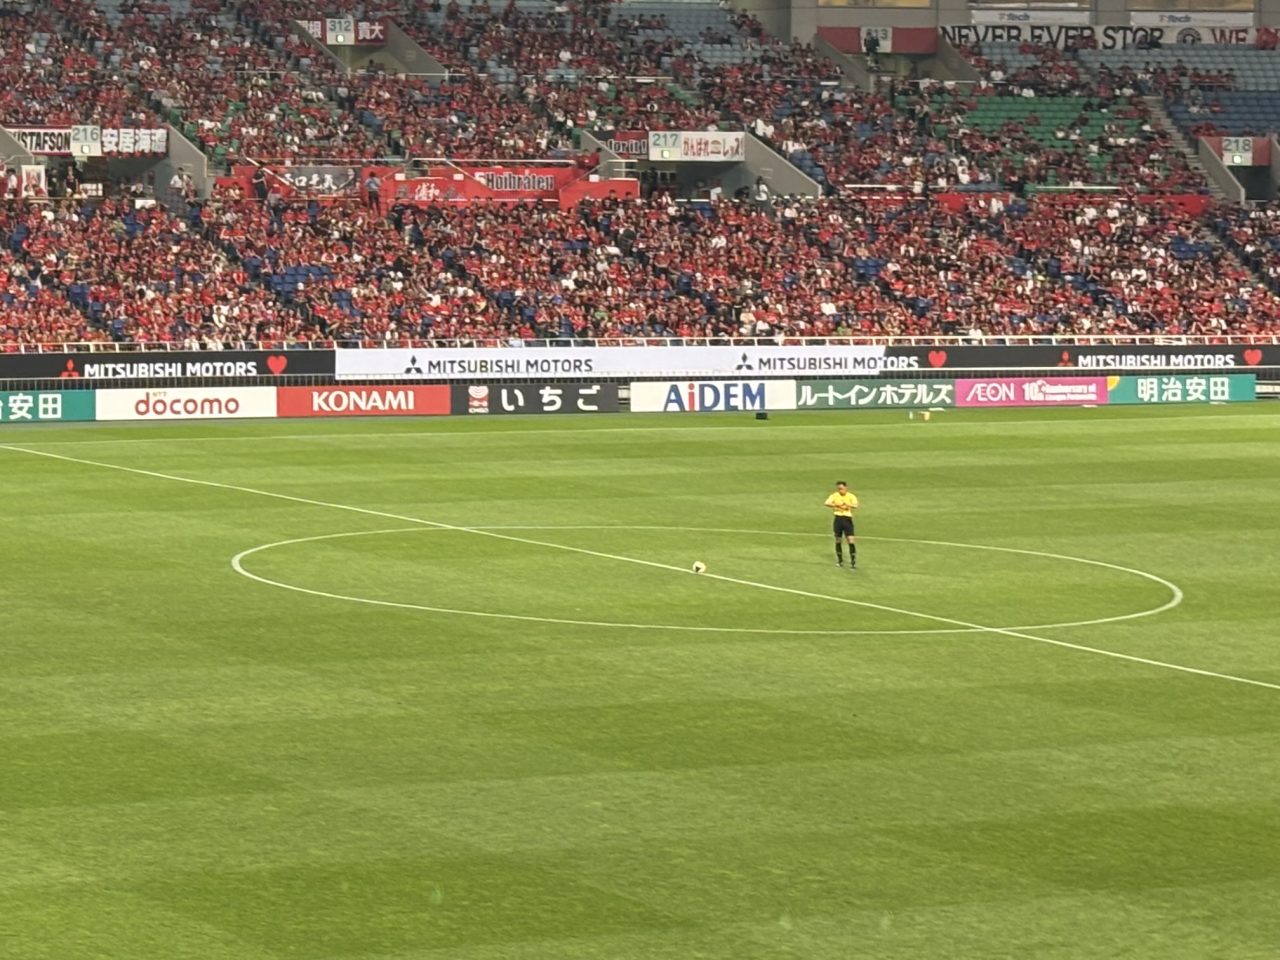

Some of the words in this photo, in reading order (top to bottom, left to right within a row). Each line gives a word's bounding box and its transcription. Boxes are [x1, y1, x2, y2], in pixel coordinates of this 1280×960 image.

[329, 20, 352, 33] 312
[940, 25, 1022, 48] NEVER
[1031, 25, 1096, 52] EVER
[72, 127, 99, 142] 216
[652, 132, 679, 146] 217
[1223, 138, 1252, 152] 218
[84, 361, 182, 378] MITSUBISHI
[185, 360, 257, 376] MOTORS
[427, 359, 521, 374] MITSUBISHI
[526, 358, 593, 373] MOTORS
[758, 356, 848, 370] MITSUBISHI
[853, 355, 919, 370] MOTORS
[1078, 354, 1167, 368] MITSUBISHI
[1171, 353, 1236, 368] MOTORS
[501, 385, 601, 411] いちご
[663, 382, 766, 411] AiDEM
[798, 384, 953, 406] ルートインホテルズ
[1137, 376, 1230, 402] 明治安田
[134, 391, 240, 415] docomo
[312, 390, 415, 412] KONAMI
